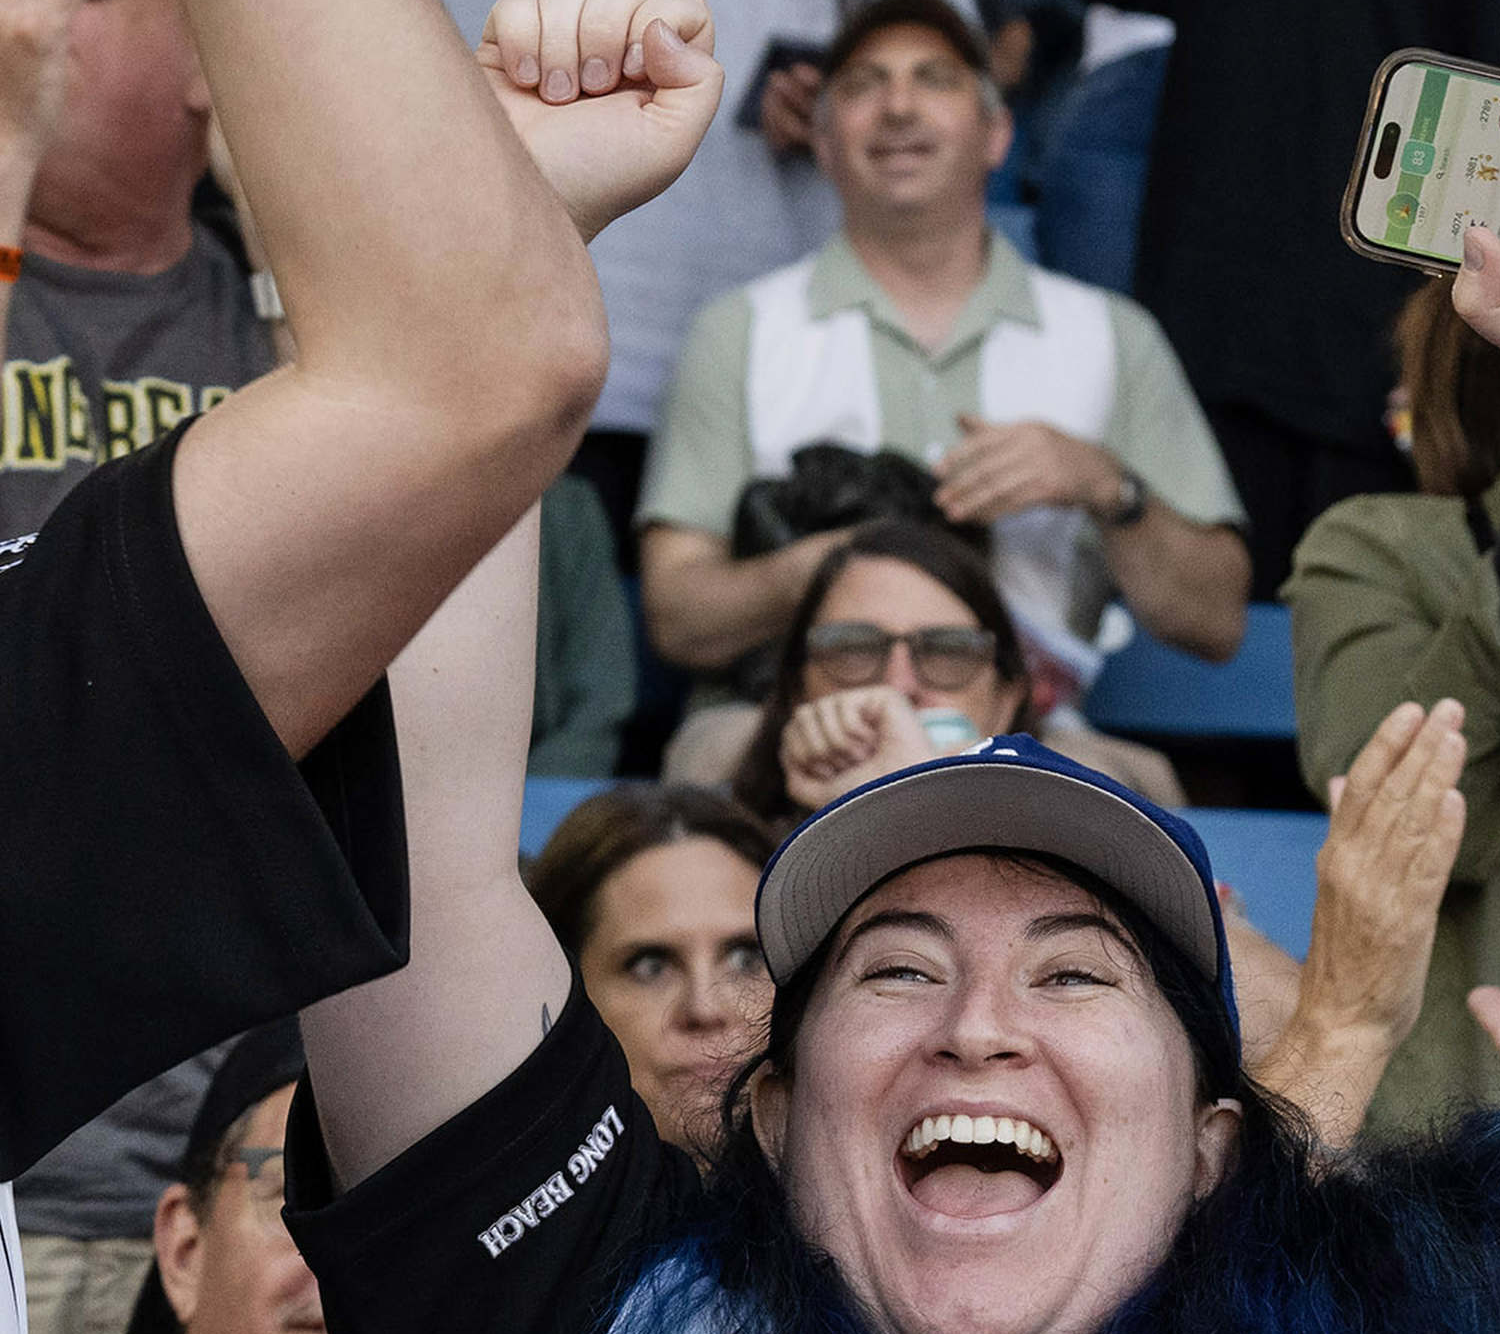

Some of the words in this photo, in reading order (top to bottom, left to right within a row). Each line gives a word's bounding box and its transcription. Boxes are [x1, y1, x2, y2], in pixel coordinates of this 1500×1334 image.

[1411, 149, 1426, 167] 83
[567, 1104, 626, 1185] LONG
[476, 1170, 576, 1260] BEACH
